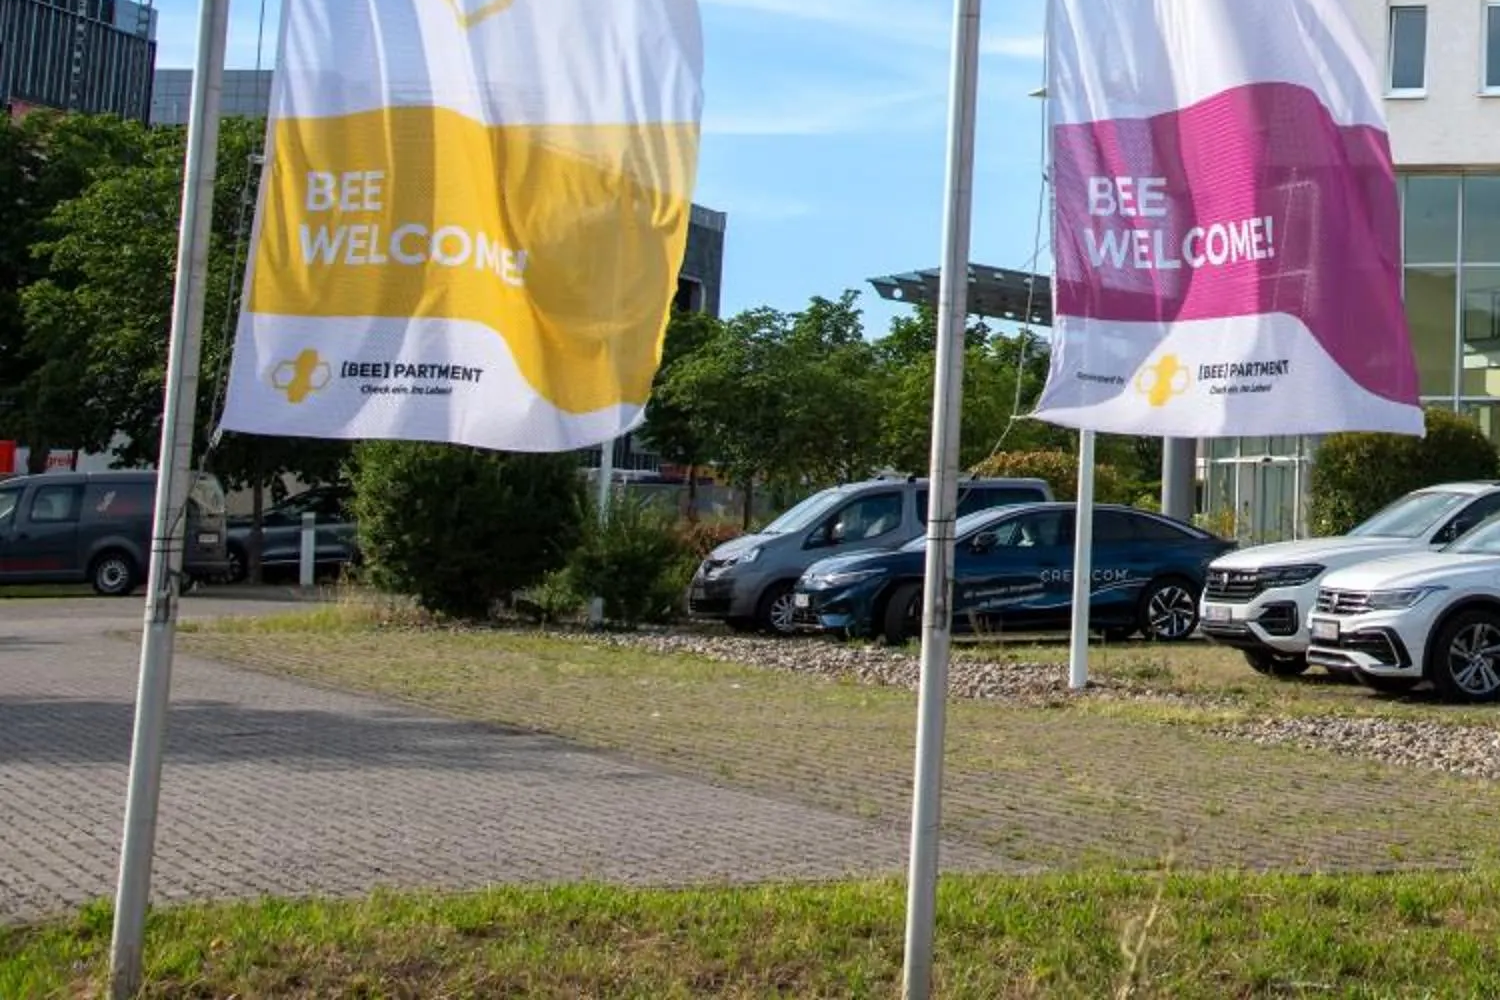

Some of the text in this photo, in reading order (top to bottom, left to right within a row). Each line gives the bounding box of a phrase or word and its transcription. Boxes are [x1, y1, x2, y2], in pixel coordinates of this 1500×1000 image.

[305, 170, 385, 213] BEE
[1087, 176, 1168, 218] BEE
[1084, 215, 1276, 270] WELCOME!
[341, 361, 484, 383] [BEE] PARTMENT
[1229, 360, 1289, 377] PARTMENT
